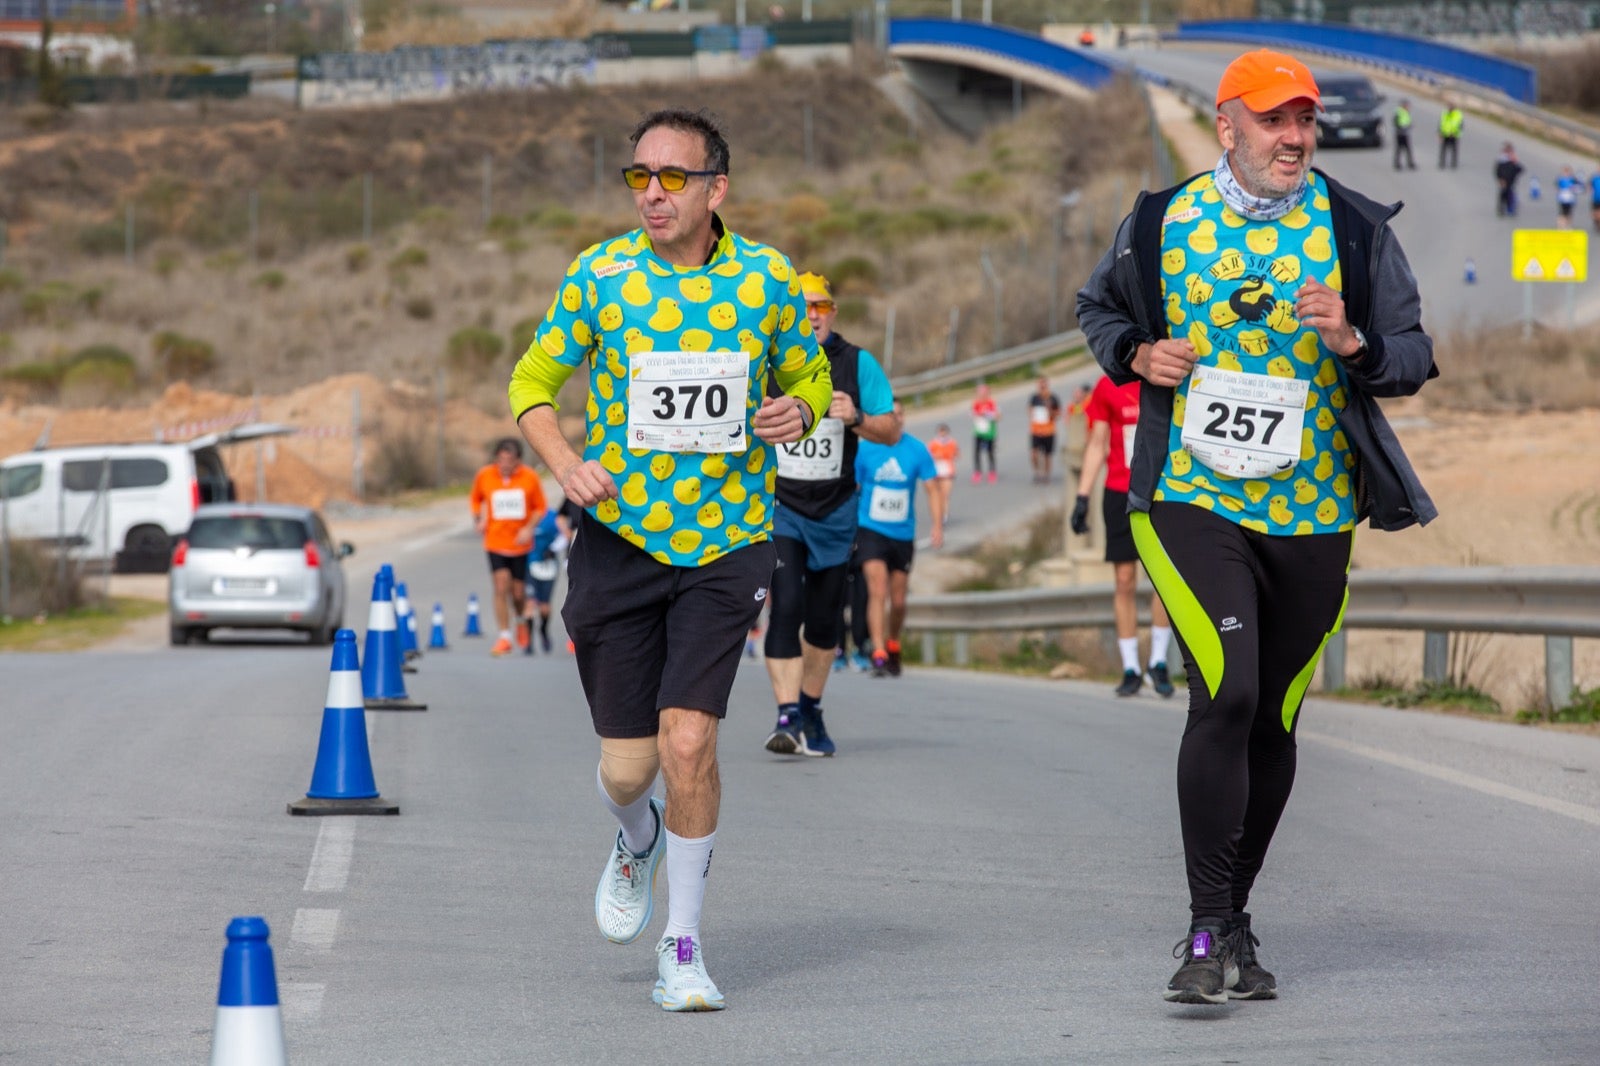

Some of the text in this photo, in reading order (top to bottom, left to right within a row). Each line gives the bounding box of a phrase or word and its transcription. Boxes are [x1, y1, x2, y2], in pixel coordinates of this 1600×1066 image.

[1208, 255, 1290, 286] BAR SORIA
[652, 384, 728, 420] 370
[1203, 402, 1285, 445] 257
[788, 438, 831, 459] 203
